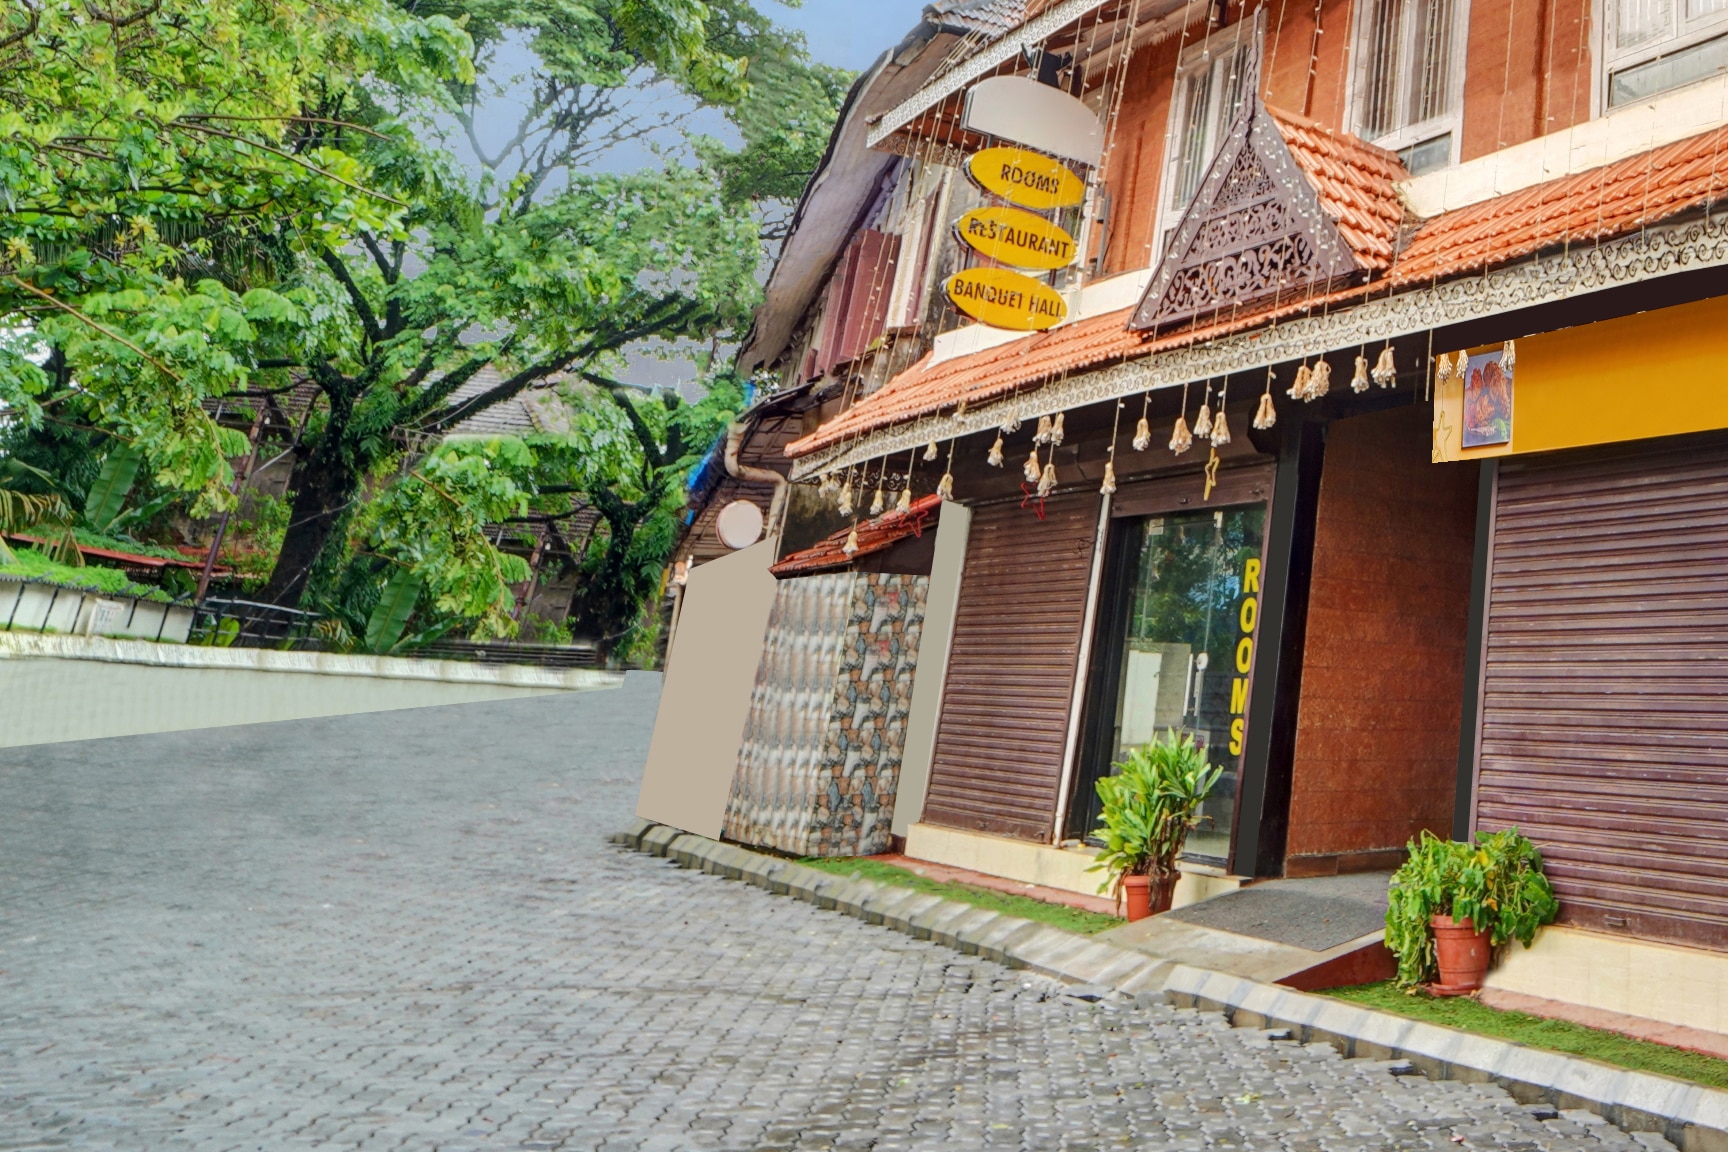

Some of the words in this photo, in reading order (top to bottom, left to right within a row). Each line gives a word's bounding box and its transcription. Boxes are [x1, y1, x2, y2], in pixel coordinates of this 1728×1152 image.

[1000, 163, 1060, 194] ROOMS
[968, 217, 1070, 259] RESTAURANT
[953, 278, 1024, 310] BANQUET
[1028, 294, 1062, 318] HALL
[1228, 558, 1261, 757] ROOMS
